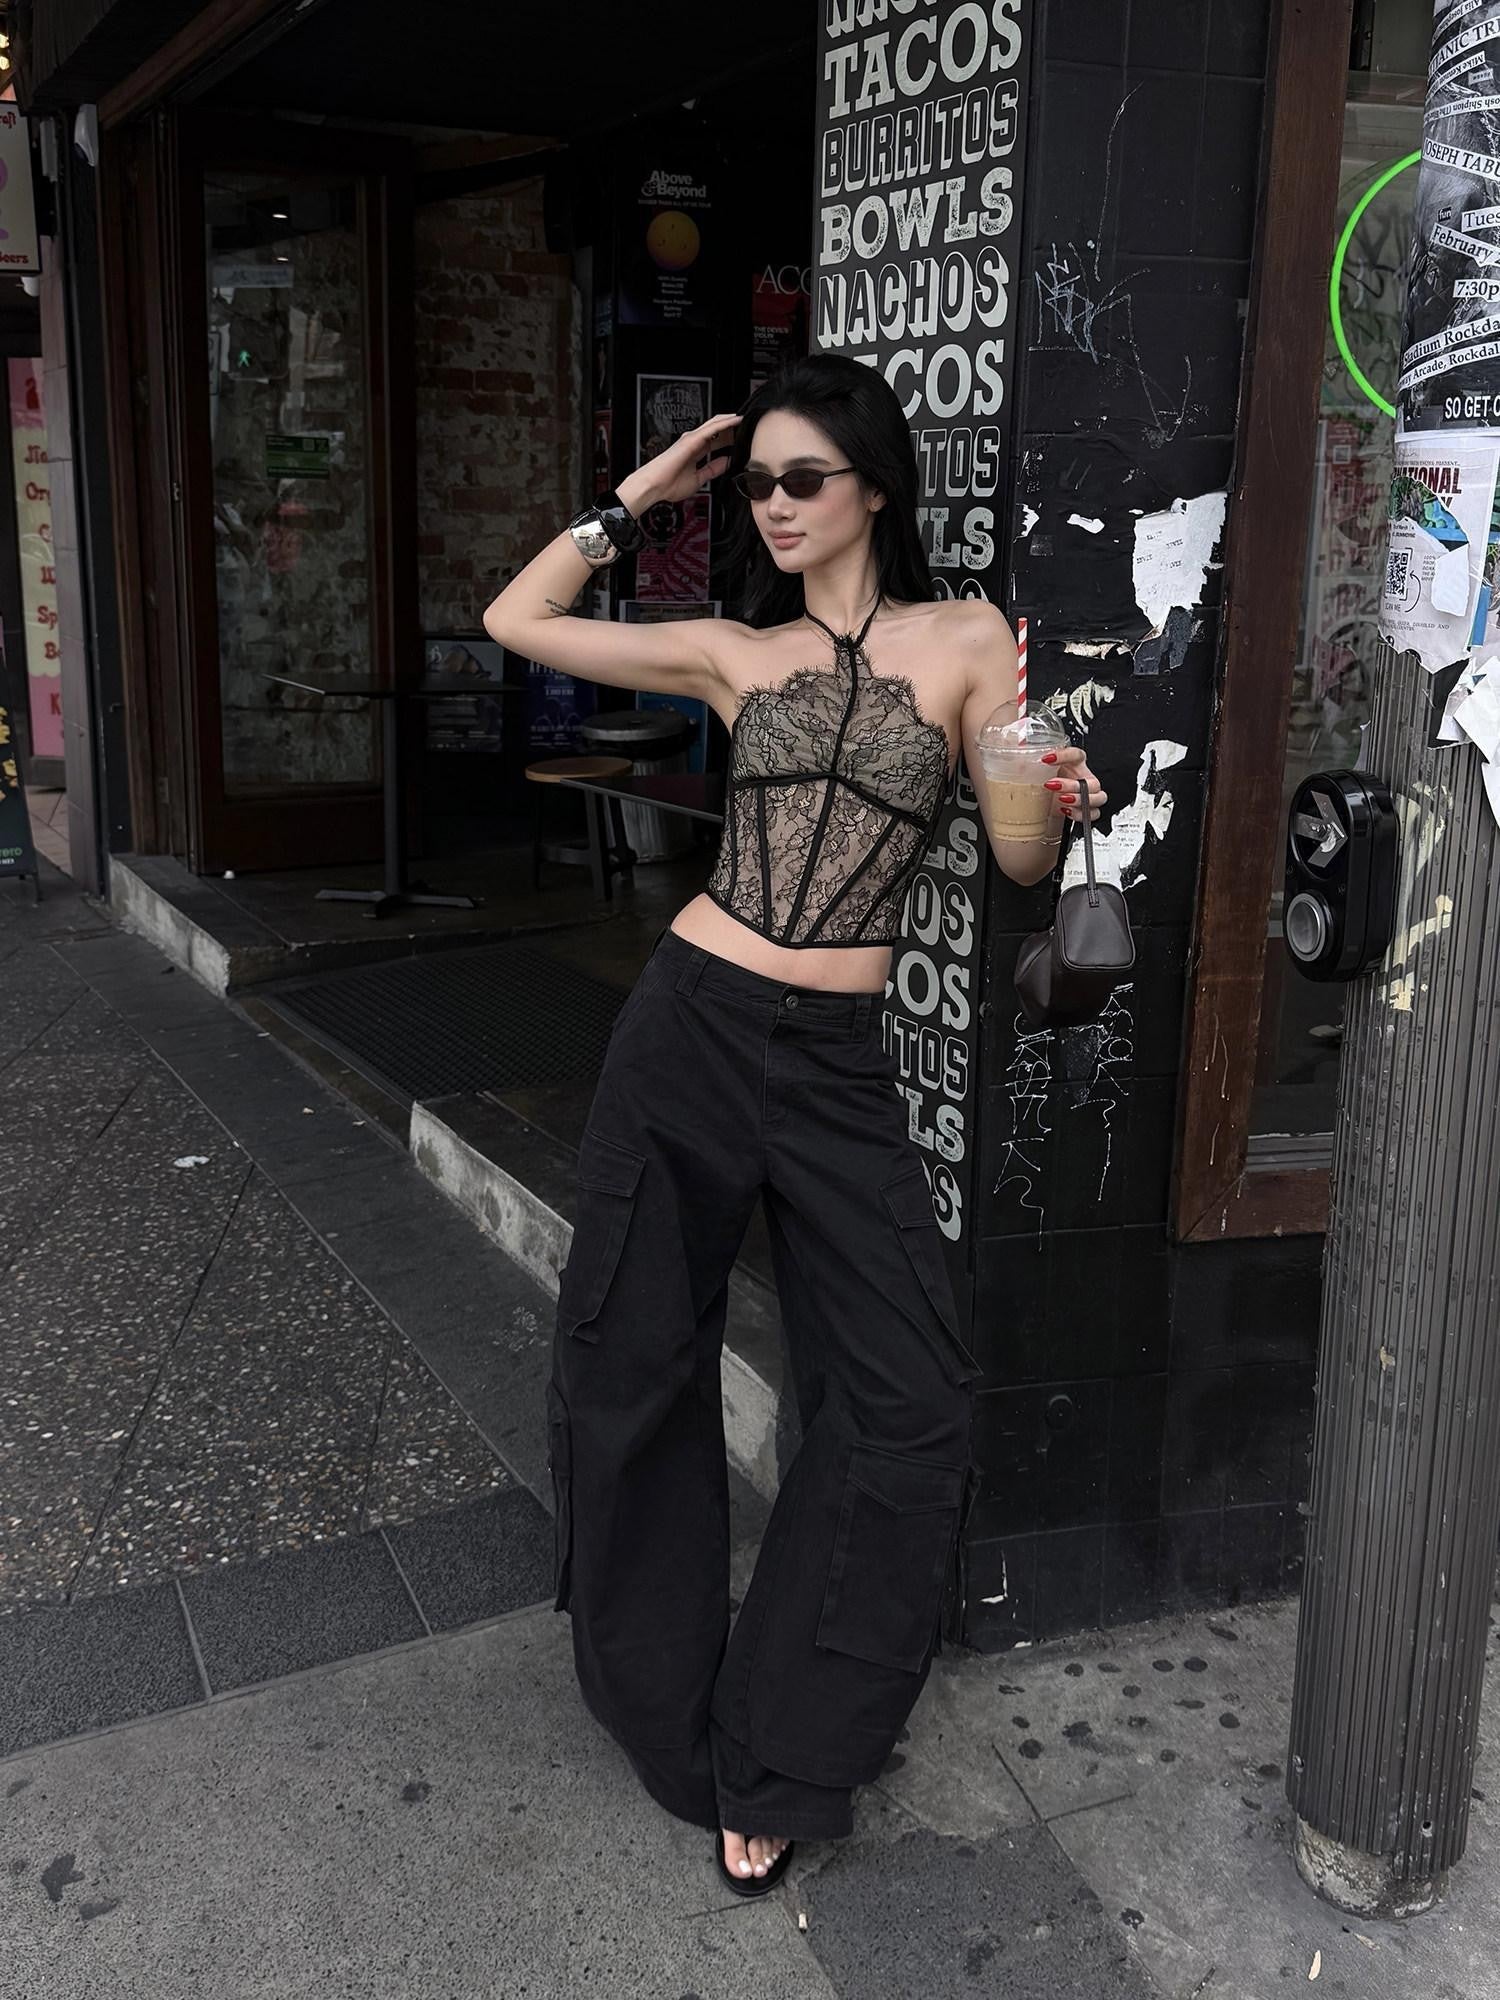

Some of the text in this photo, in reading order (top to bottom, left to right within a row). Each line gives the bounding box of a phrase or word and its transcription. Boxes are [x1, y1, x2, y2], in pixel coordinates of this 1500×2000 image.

[824, 0, 1022, 119] TACOS
[1463, 54, 1484, 69] Mike
[821, 78, 1019, 198] BURRITOS
[1453, 99, 1482, 110] Shipton
[650, 170, 693, 185] Above
[657, 184, 707, 198] Beyond
[820, 166, 1013, 266] BOWLS
[1433, 225, 1494, 262] February
[817, 245, 1009, 349] NACHOS
[853, 339, 1004, 420] COS
[1413, 359, 1447, 379] Arcade,
[1445, 396, 1461, 418] SO
[1464, 395, 1491, 418] GET
[916, 507, 995, 570] LS
[901, 873, 974, 956] OS
[886, 950, 971, 1031] OS
[895, 1081, 965, 1162] LS
[920, 1155, 962, 1242] S
